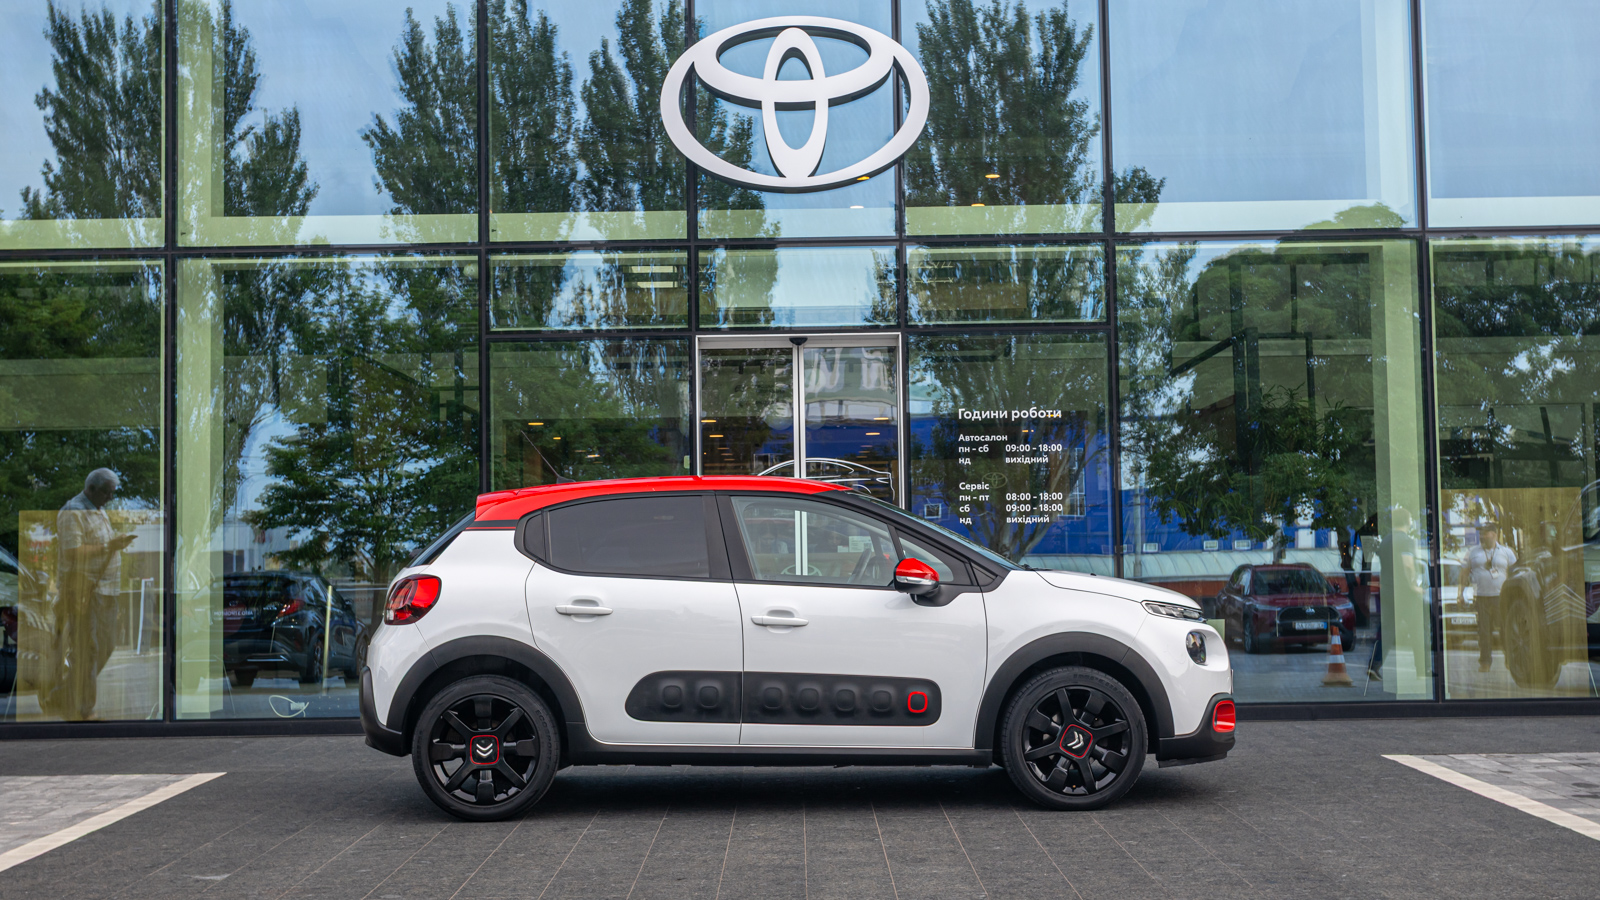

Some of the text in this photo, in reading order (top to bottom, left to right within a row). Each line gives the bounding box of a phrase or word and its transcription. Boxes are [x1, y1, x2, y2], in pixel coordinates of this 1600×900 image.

[958, 406, 1062, 421] Години роботи
[958, 433, 1008, 442] Автосалон
[978, 444, 989, 453] сб
[1005, 444, 1031, 452] 09:00
[1038, 443, 1063, 452] 18:00
[958, 455, 1049, 465] нд вихідний
[959, 482, 990, 492] Сервіс
[1005, 492, 1031, 501] 08:00
[1039, 492, 1063, 500] 18:00
[959, 503, 970, 512] сб
[1005, 503, 1031, 512] 09:00
[1039, 503, 1063, 512] 18:00
[959, 515, 1050, 525] нд вихідний
